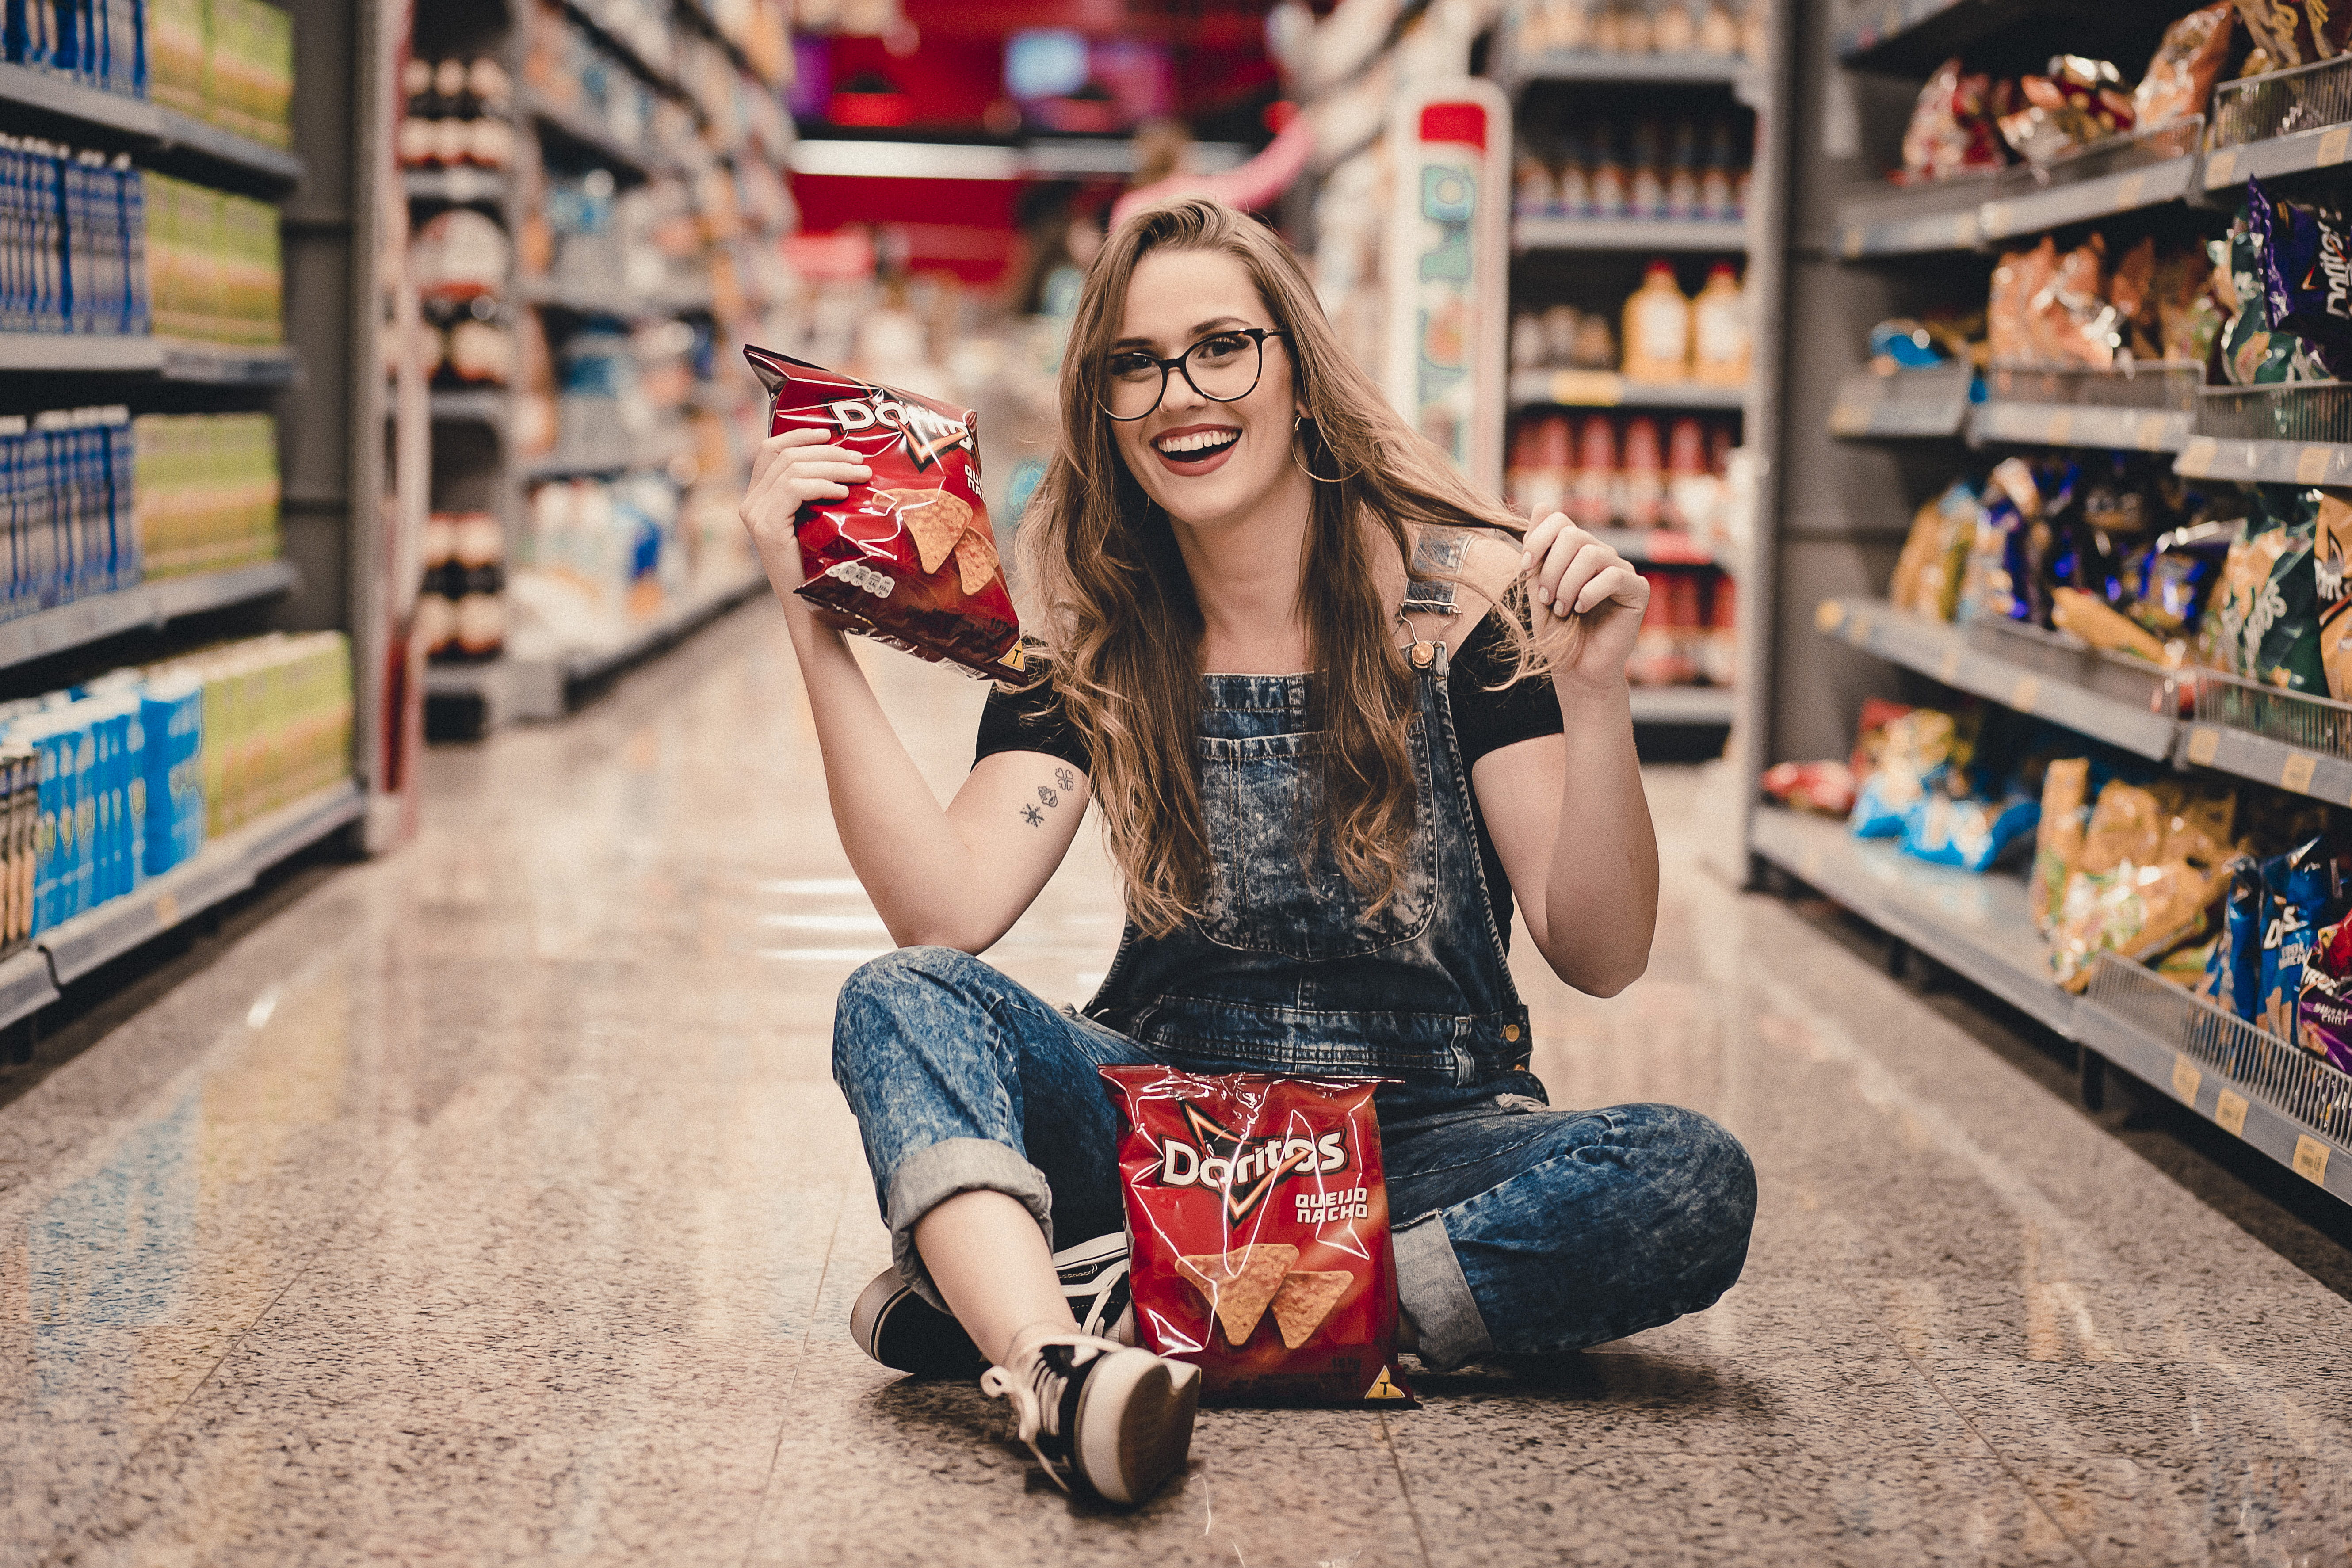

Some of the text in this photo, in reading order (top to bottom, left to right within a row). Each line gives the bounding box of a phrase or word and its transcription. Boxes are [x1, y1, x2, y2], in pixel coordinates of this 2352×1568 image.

[1014, 649, 1022, 664] T
[1163, 1132, 1345, 1186] Doritos
[1295, 1187, 1367, 1208] QUEIJO
[1297, 1203, 1367, 1223] NACHO
[1380, 1382, 1389, 1395] T
